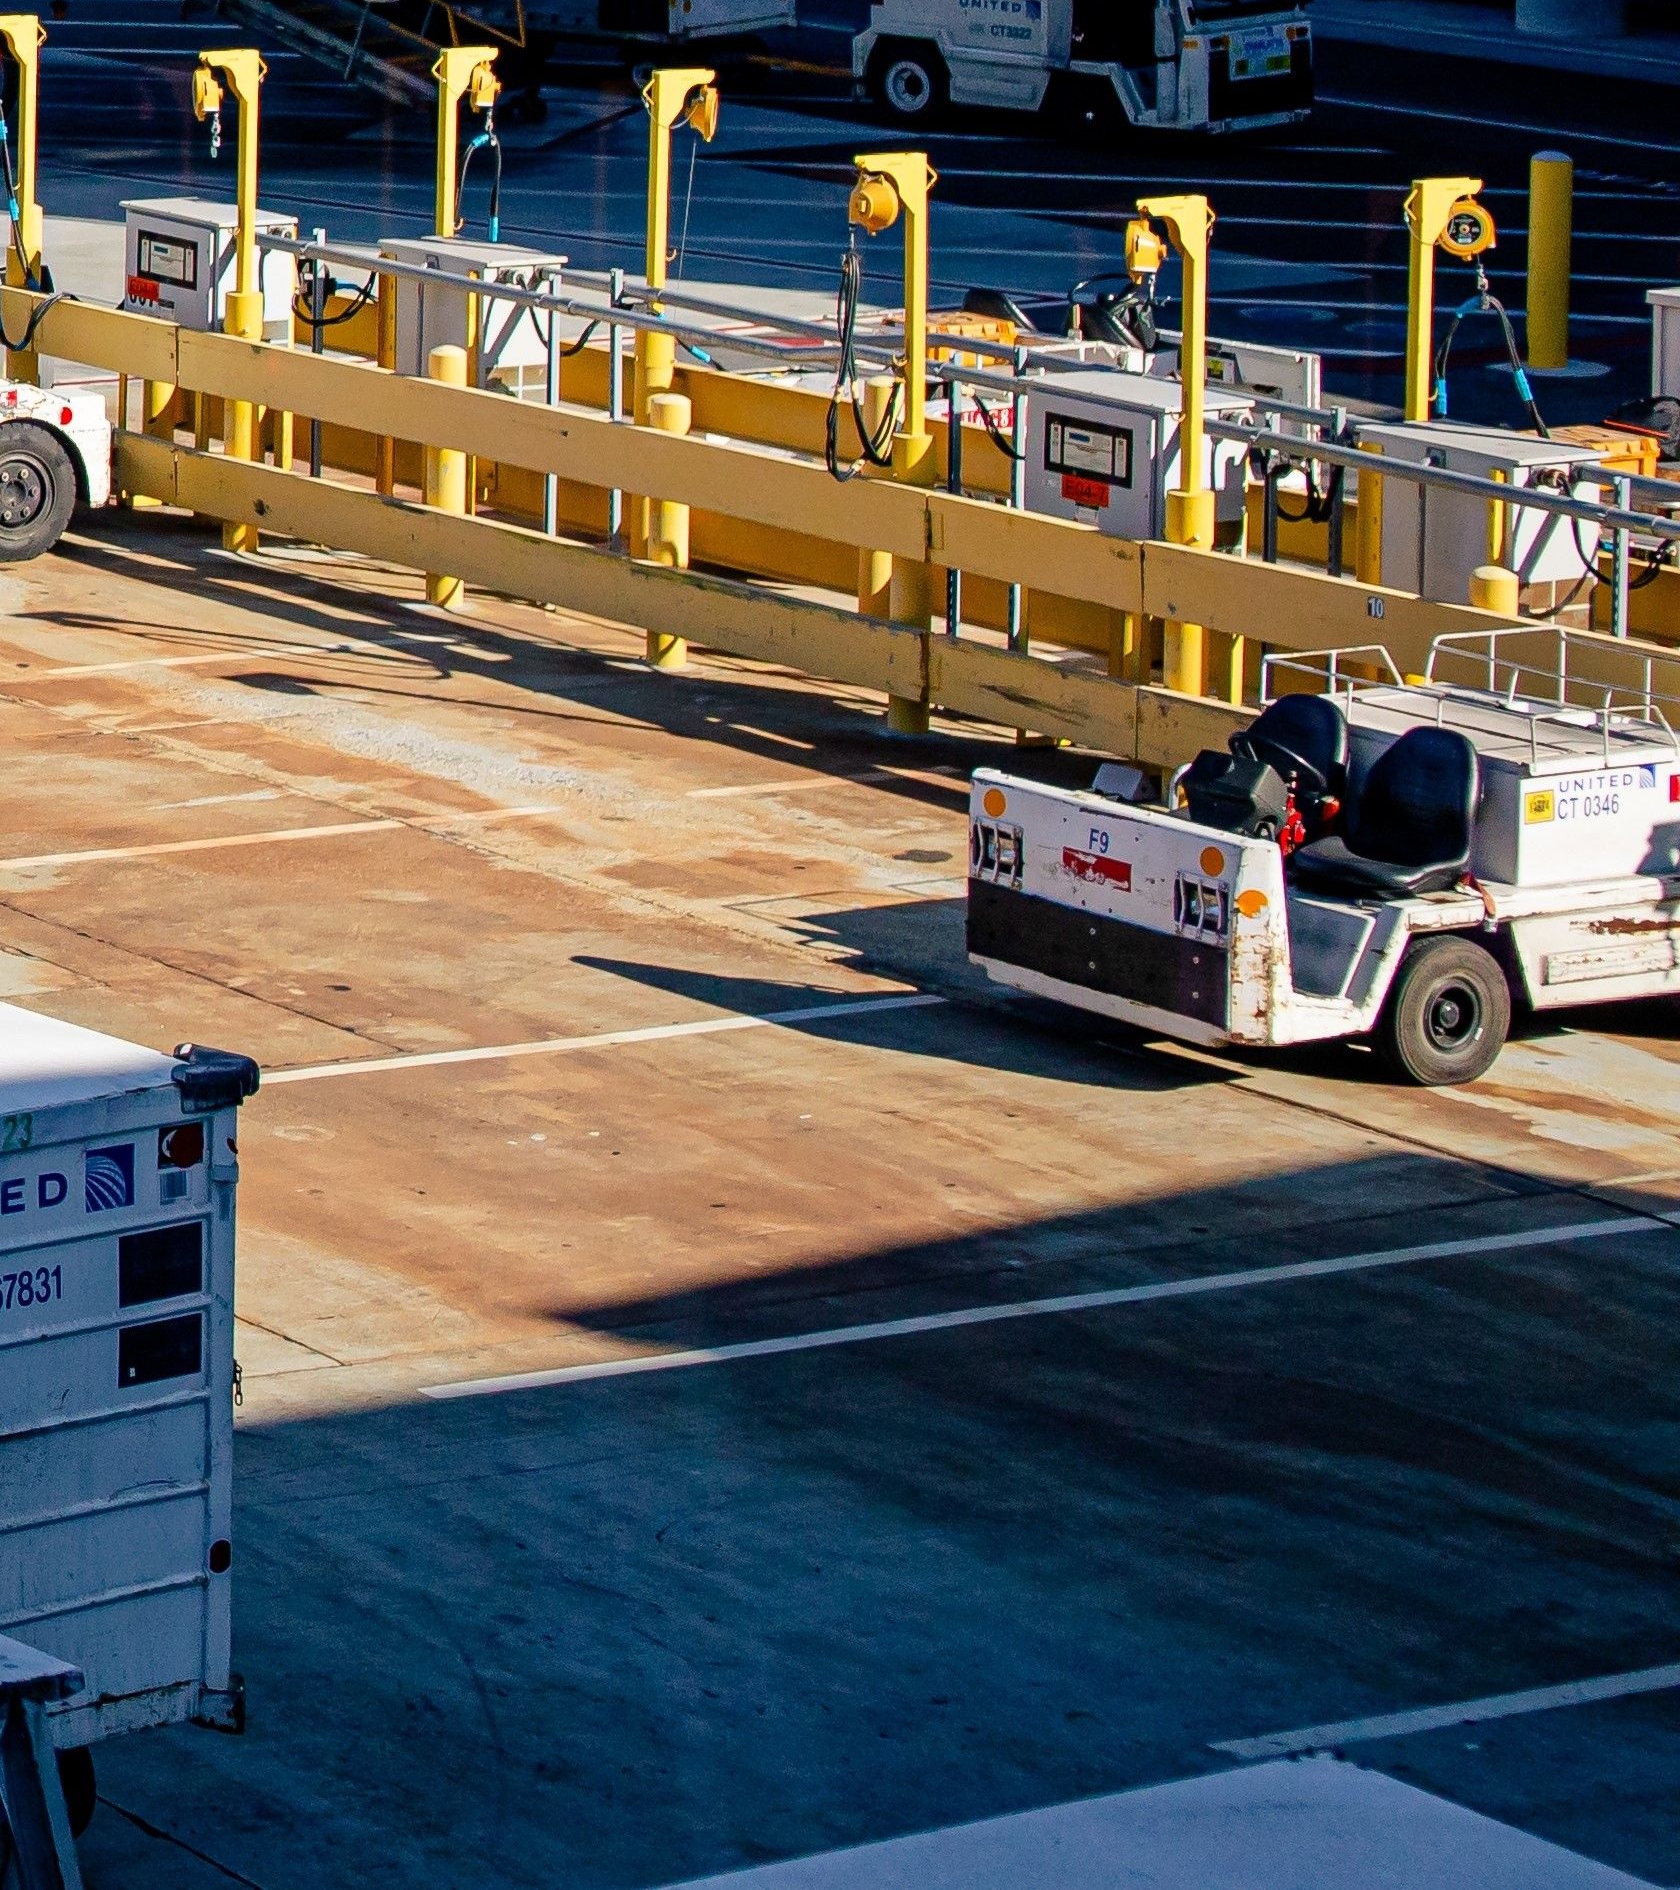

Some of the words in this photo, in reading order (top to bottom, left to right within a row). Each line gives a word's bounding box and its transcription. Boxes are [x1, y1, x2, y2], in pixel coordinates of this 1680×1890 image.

[1367, 596, 1385, 619] 10
[1558, 773, 1634, 794] UNITED
[1557, 797, 1577, 821] CT
[1583, 793, 1620, 817] 0346
[1088, 827, 1110, 854] F9
[3, 1112, 34, 1151] 23
